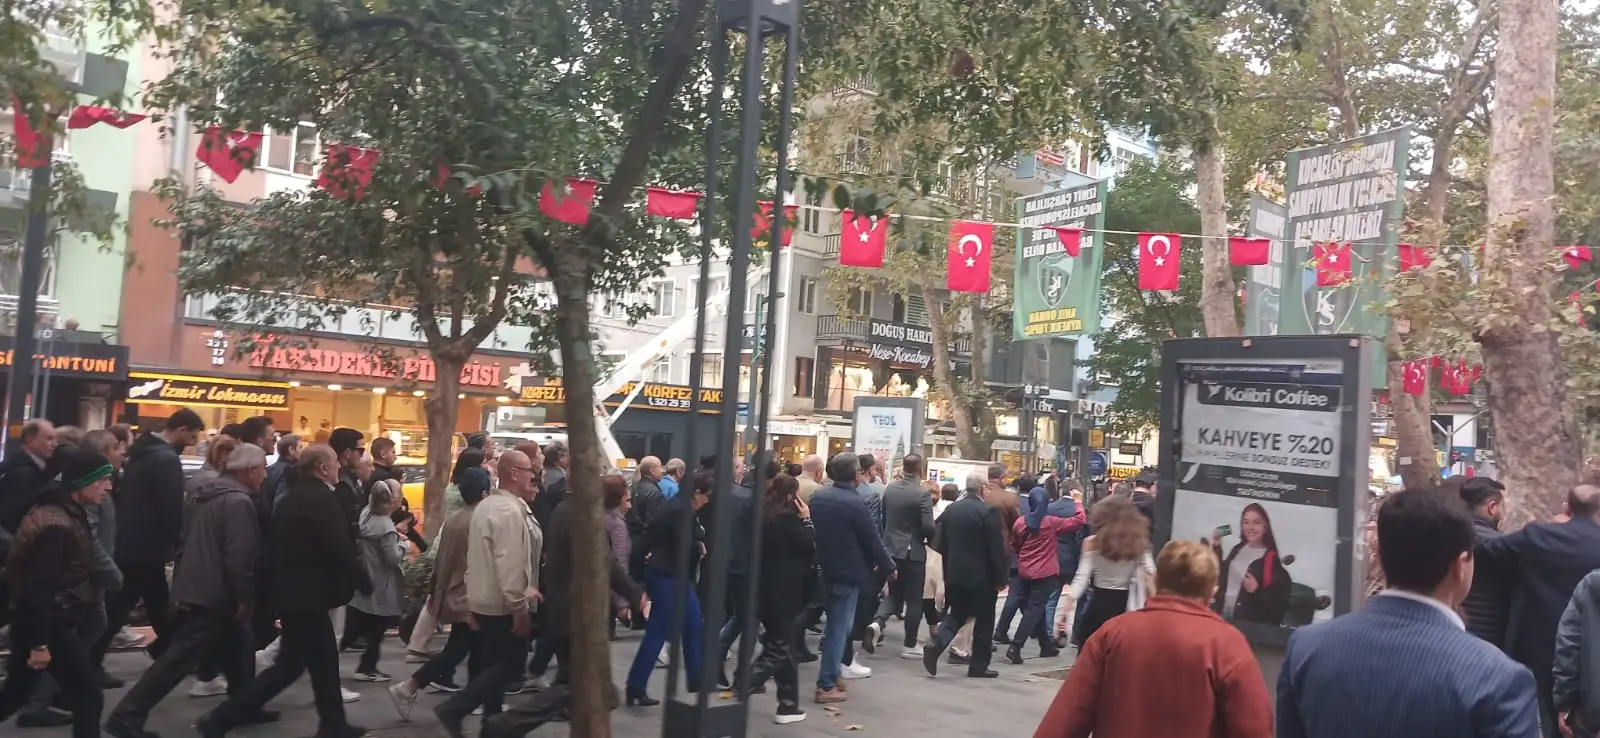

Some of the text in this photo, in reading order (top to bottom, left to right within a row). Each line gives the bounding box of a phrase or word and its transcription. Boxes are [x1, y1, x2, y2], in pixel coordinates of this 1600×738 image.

[871, 321, 905, 341] DOĞUŞ
[32, 353, 116, 373] ANTUNİ
[402, 355, 501, 387] PİCİSİ
[643, 384, 693, 400] KÖRFEZ
[698, 389, 723, 403] TAK
[1224, 386, 1329, 407] Kolibri Coffee
[1197, 428, 1334, 455] KAHVEYE %20
